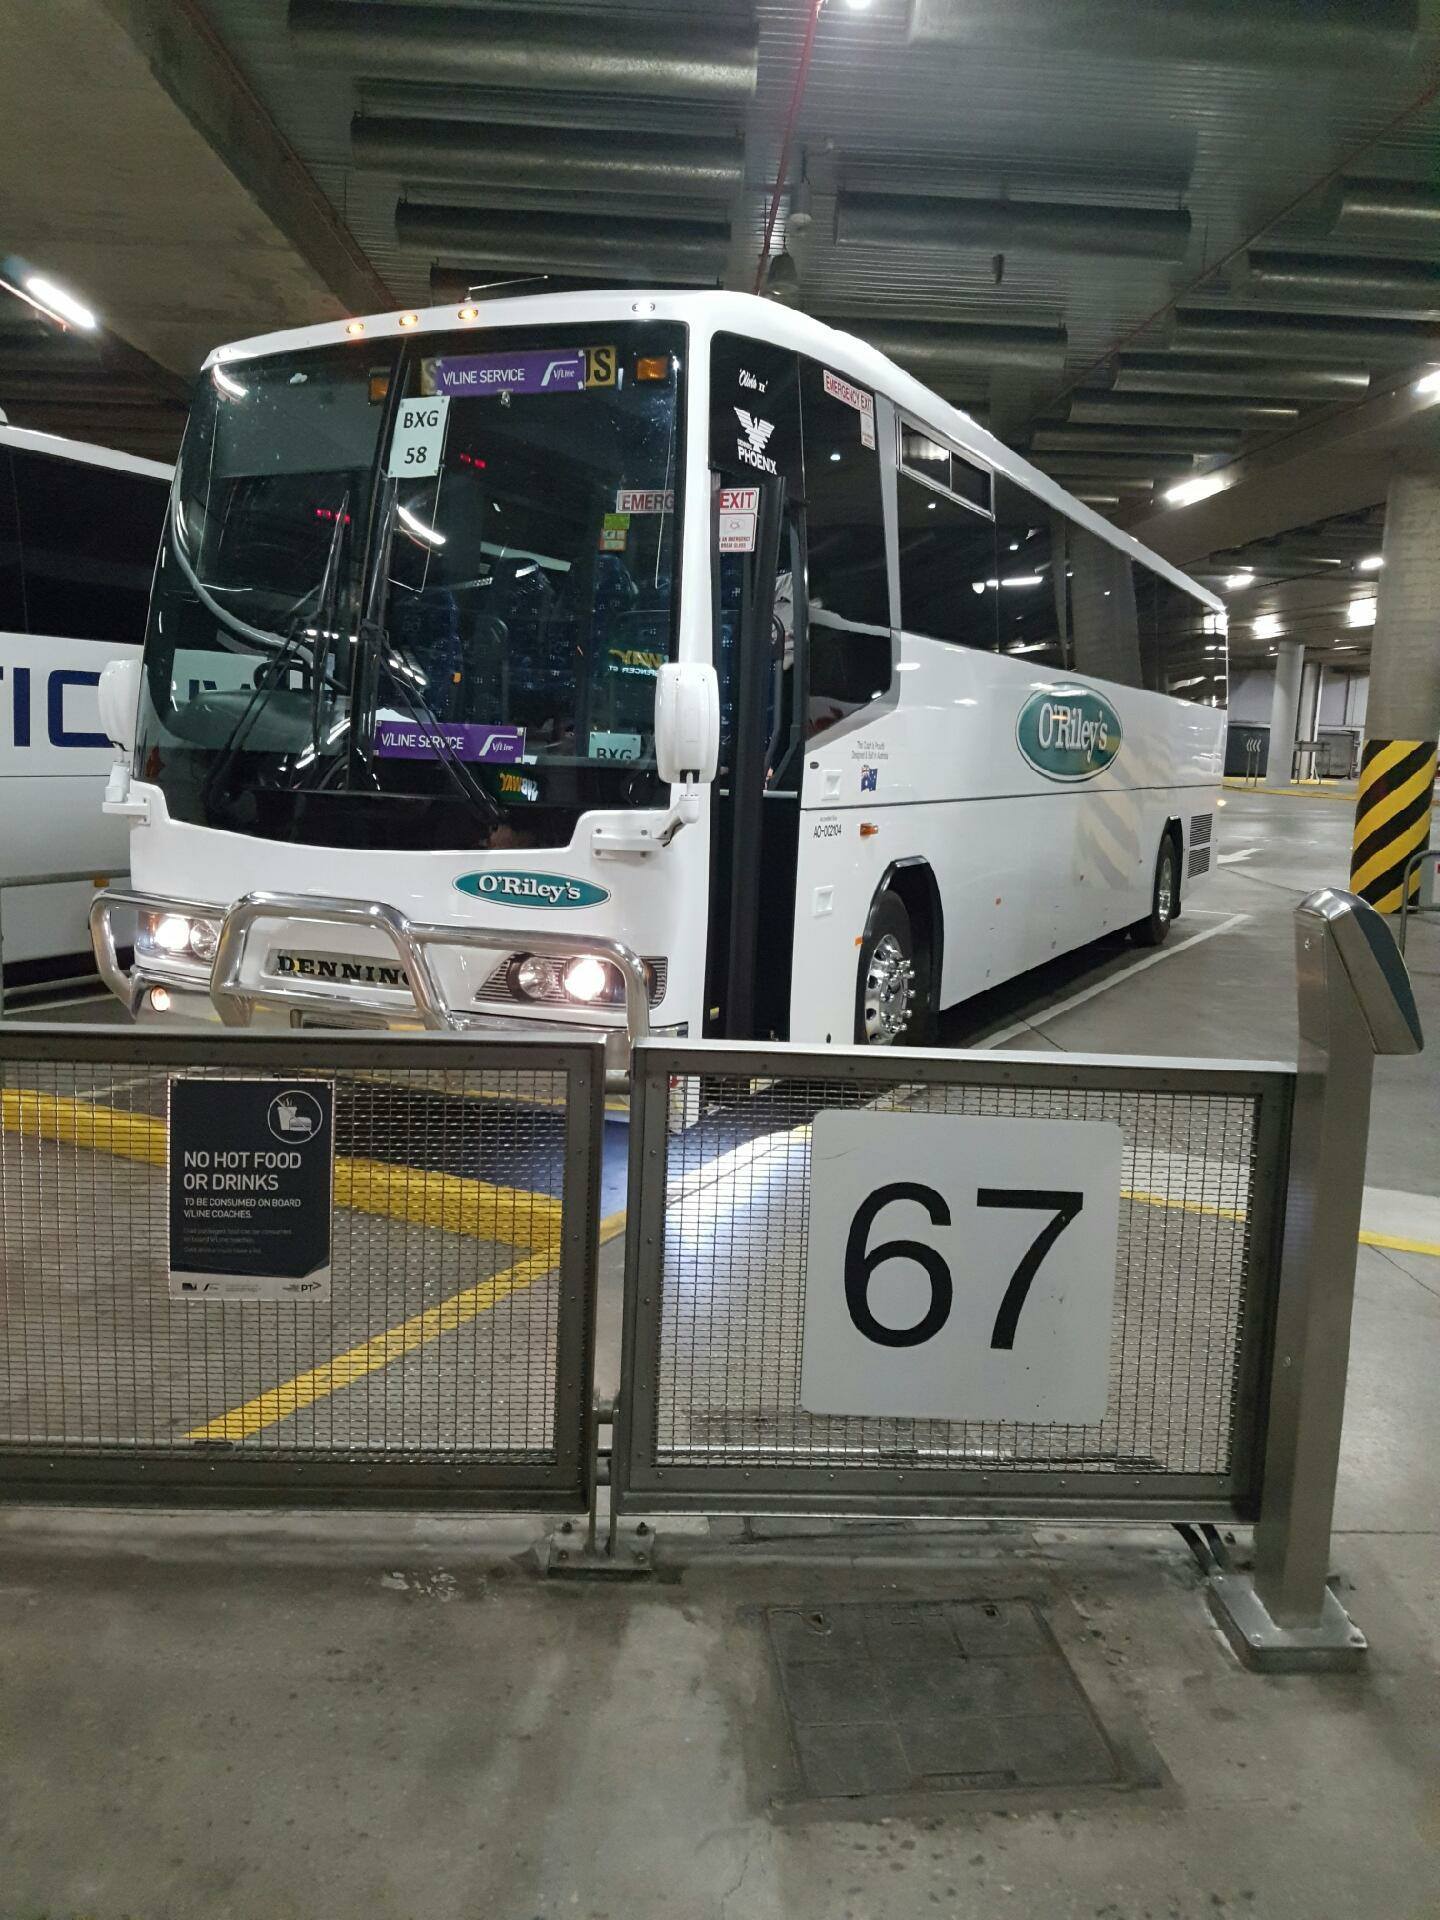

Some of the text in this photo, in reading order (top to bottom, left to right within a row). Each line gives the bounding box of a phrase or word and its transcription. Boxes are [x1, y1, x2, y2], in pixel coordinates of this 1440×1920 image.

[443, 370, 478, 387] V/LINE
[480, 368, 526, 384] SERVICE
[826, 375, 872, 413] EMERGENCY EXIT
[403, 410, 439, 429] BXG
[404, 446, 428, 465] 58
[737, 445, 778, 476] PHOENIX
[720, 492, 755, 509] EXIT
[0, 666, 114, 748] IC
[381, 732, 465, 750] V/LINE SERVICE
[1039, 702, 1108, 764] O'Riley's
[478, 874, 581, 904] O'Riley's
[184, 1151, 302, 1169] NO HOT FOOD
[183, 1174, 279, 1191] OR DRINKS
[184, 1198, 301, 1208] TO BE CONSUMED ON BOARD
[844, 1181, 1084, 1350] 67
